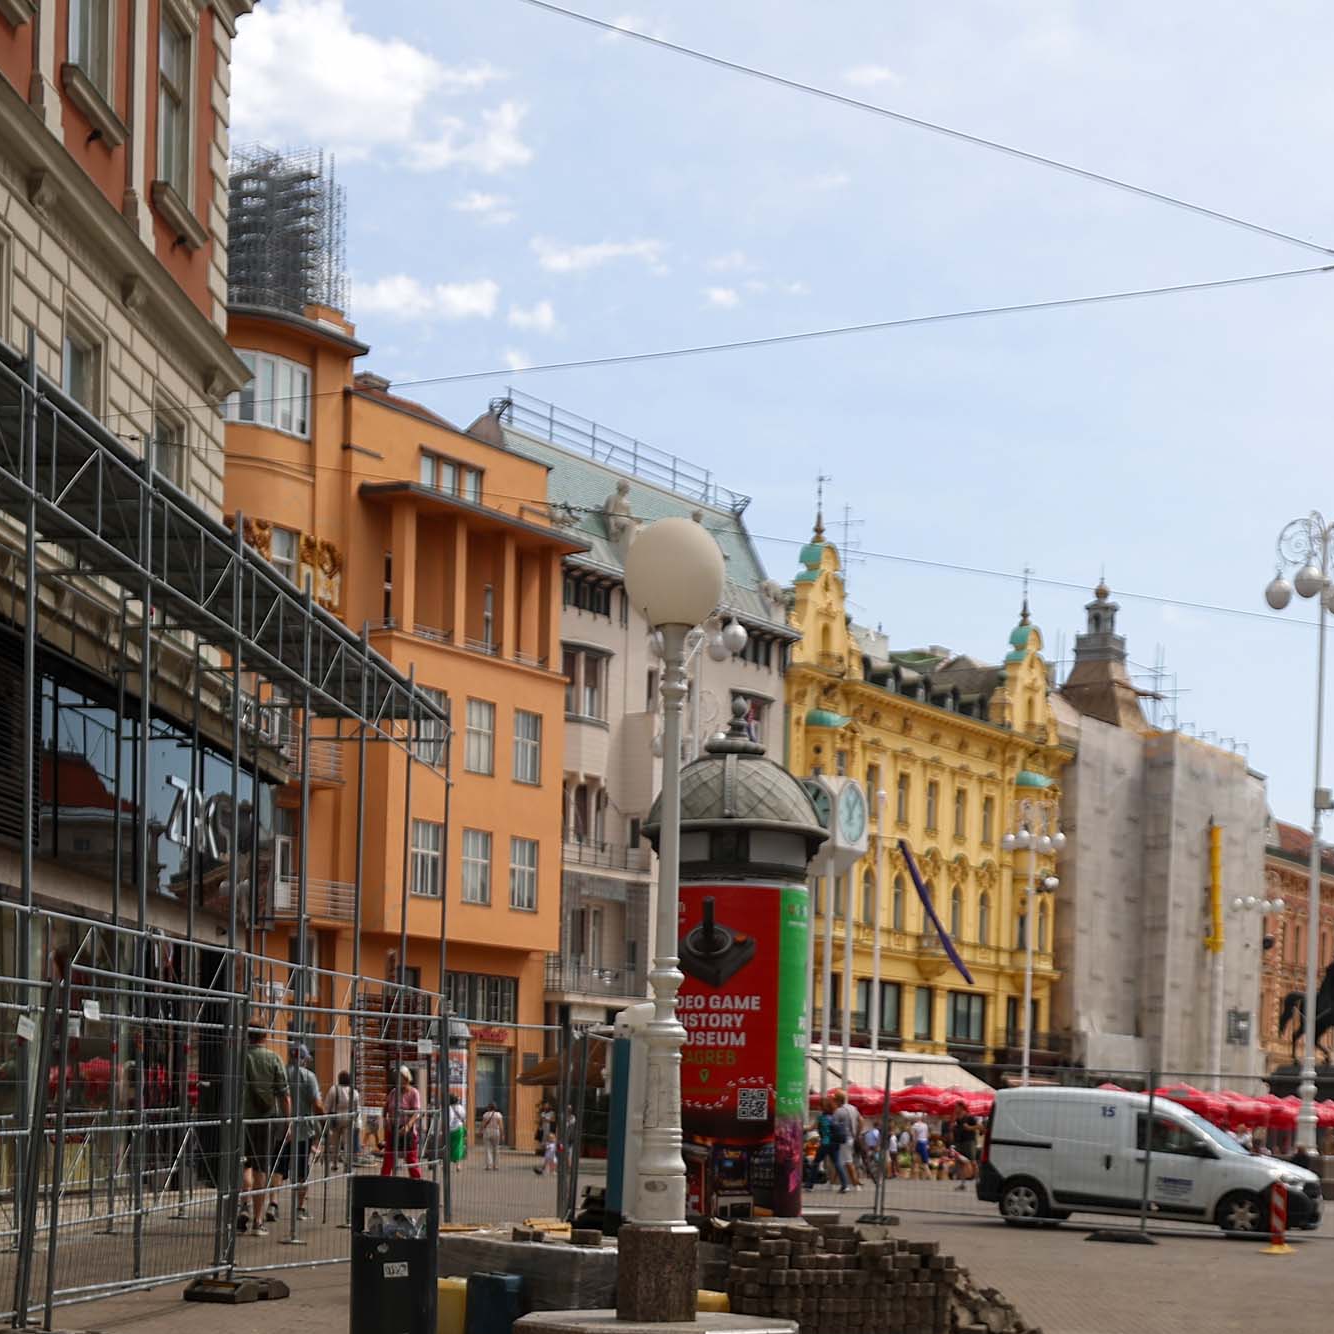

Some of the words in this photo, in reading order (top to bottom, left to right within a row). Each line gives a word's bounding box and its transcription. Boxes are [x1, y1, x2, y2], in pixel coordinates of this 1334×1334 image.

[676, 995, 706, 1009] DEO
[709, 995, 761, 1011] GAME
[685, 1031, 747, 1046] USEUM
[684, 1049, 737, 1064] AGREB
